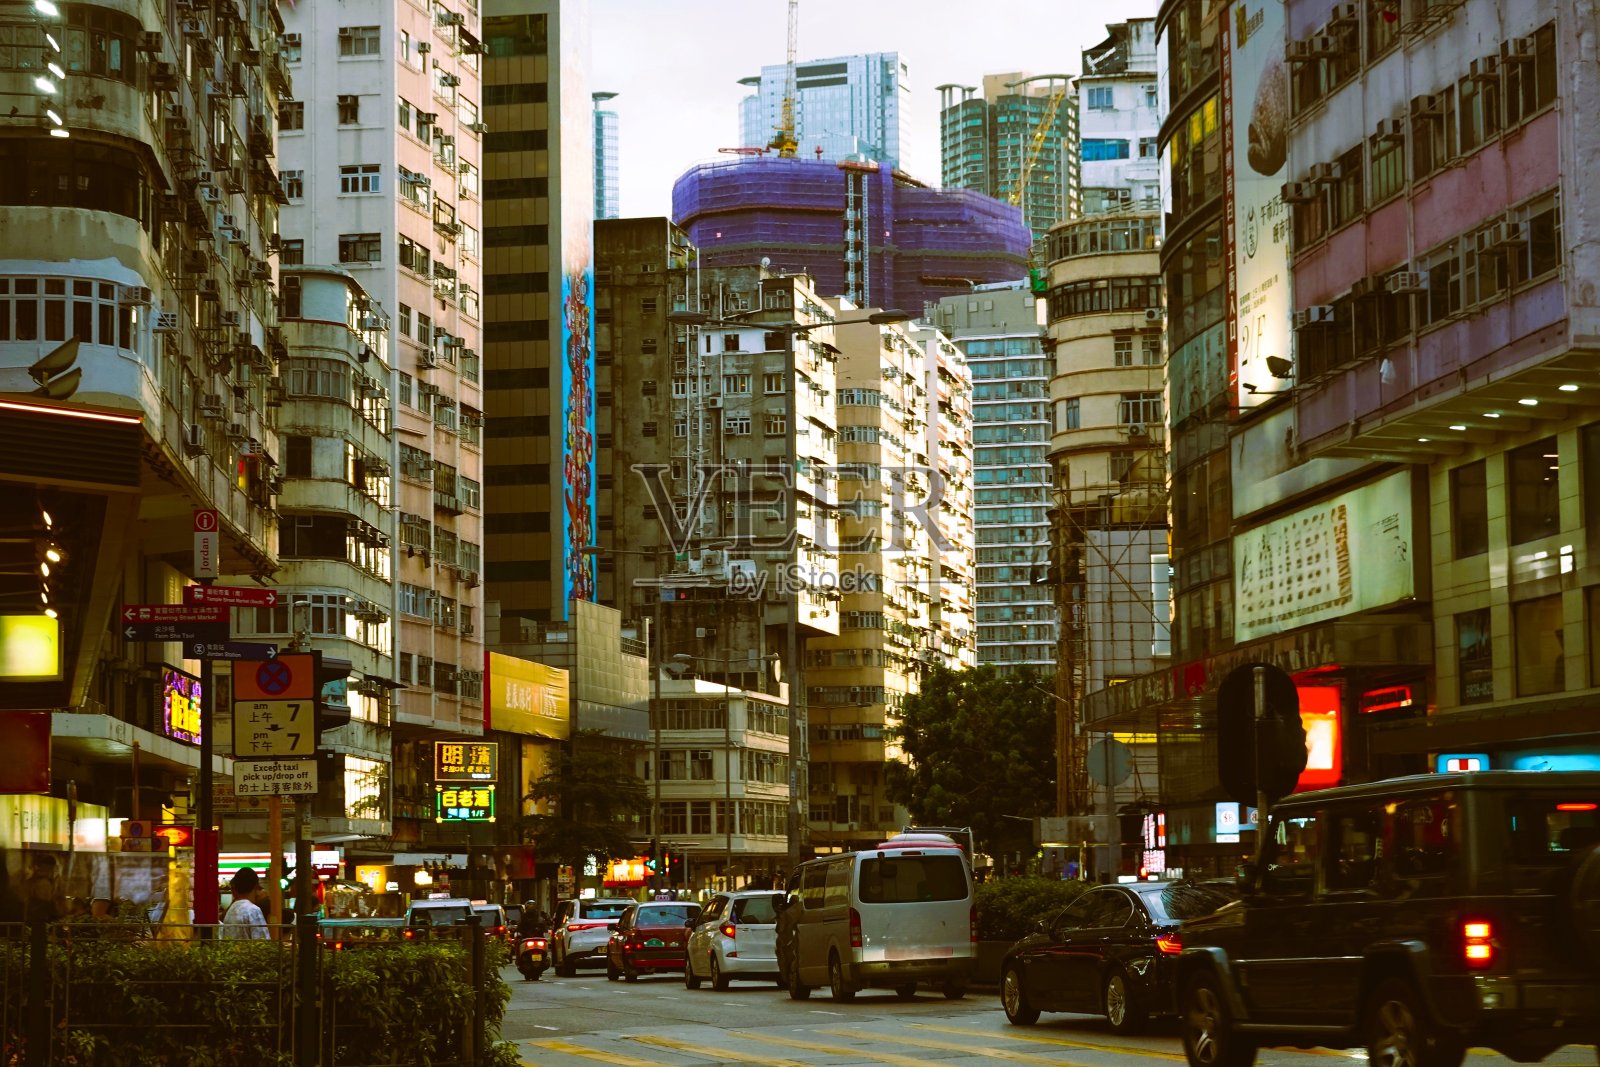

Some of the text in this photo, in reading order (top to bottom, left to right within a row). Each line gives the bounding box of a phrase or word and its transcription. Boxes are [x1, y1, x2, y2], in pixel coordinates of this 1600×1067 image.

[200, 538, 212, 572] Jordan
[249, 712, 272, 723] 上午
[287, 704, 301, 722] 7
[249, 741, 272, 752] 下午
[287, 733, 301, 751] 7
[253, 764, 281, 772] Except
[243, 772, 260, 781] pick
[262, 772, 295, 781] up/drop
[239, 782, 313, 792] 的士上落客除外
